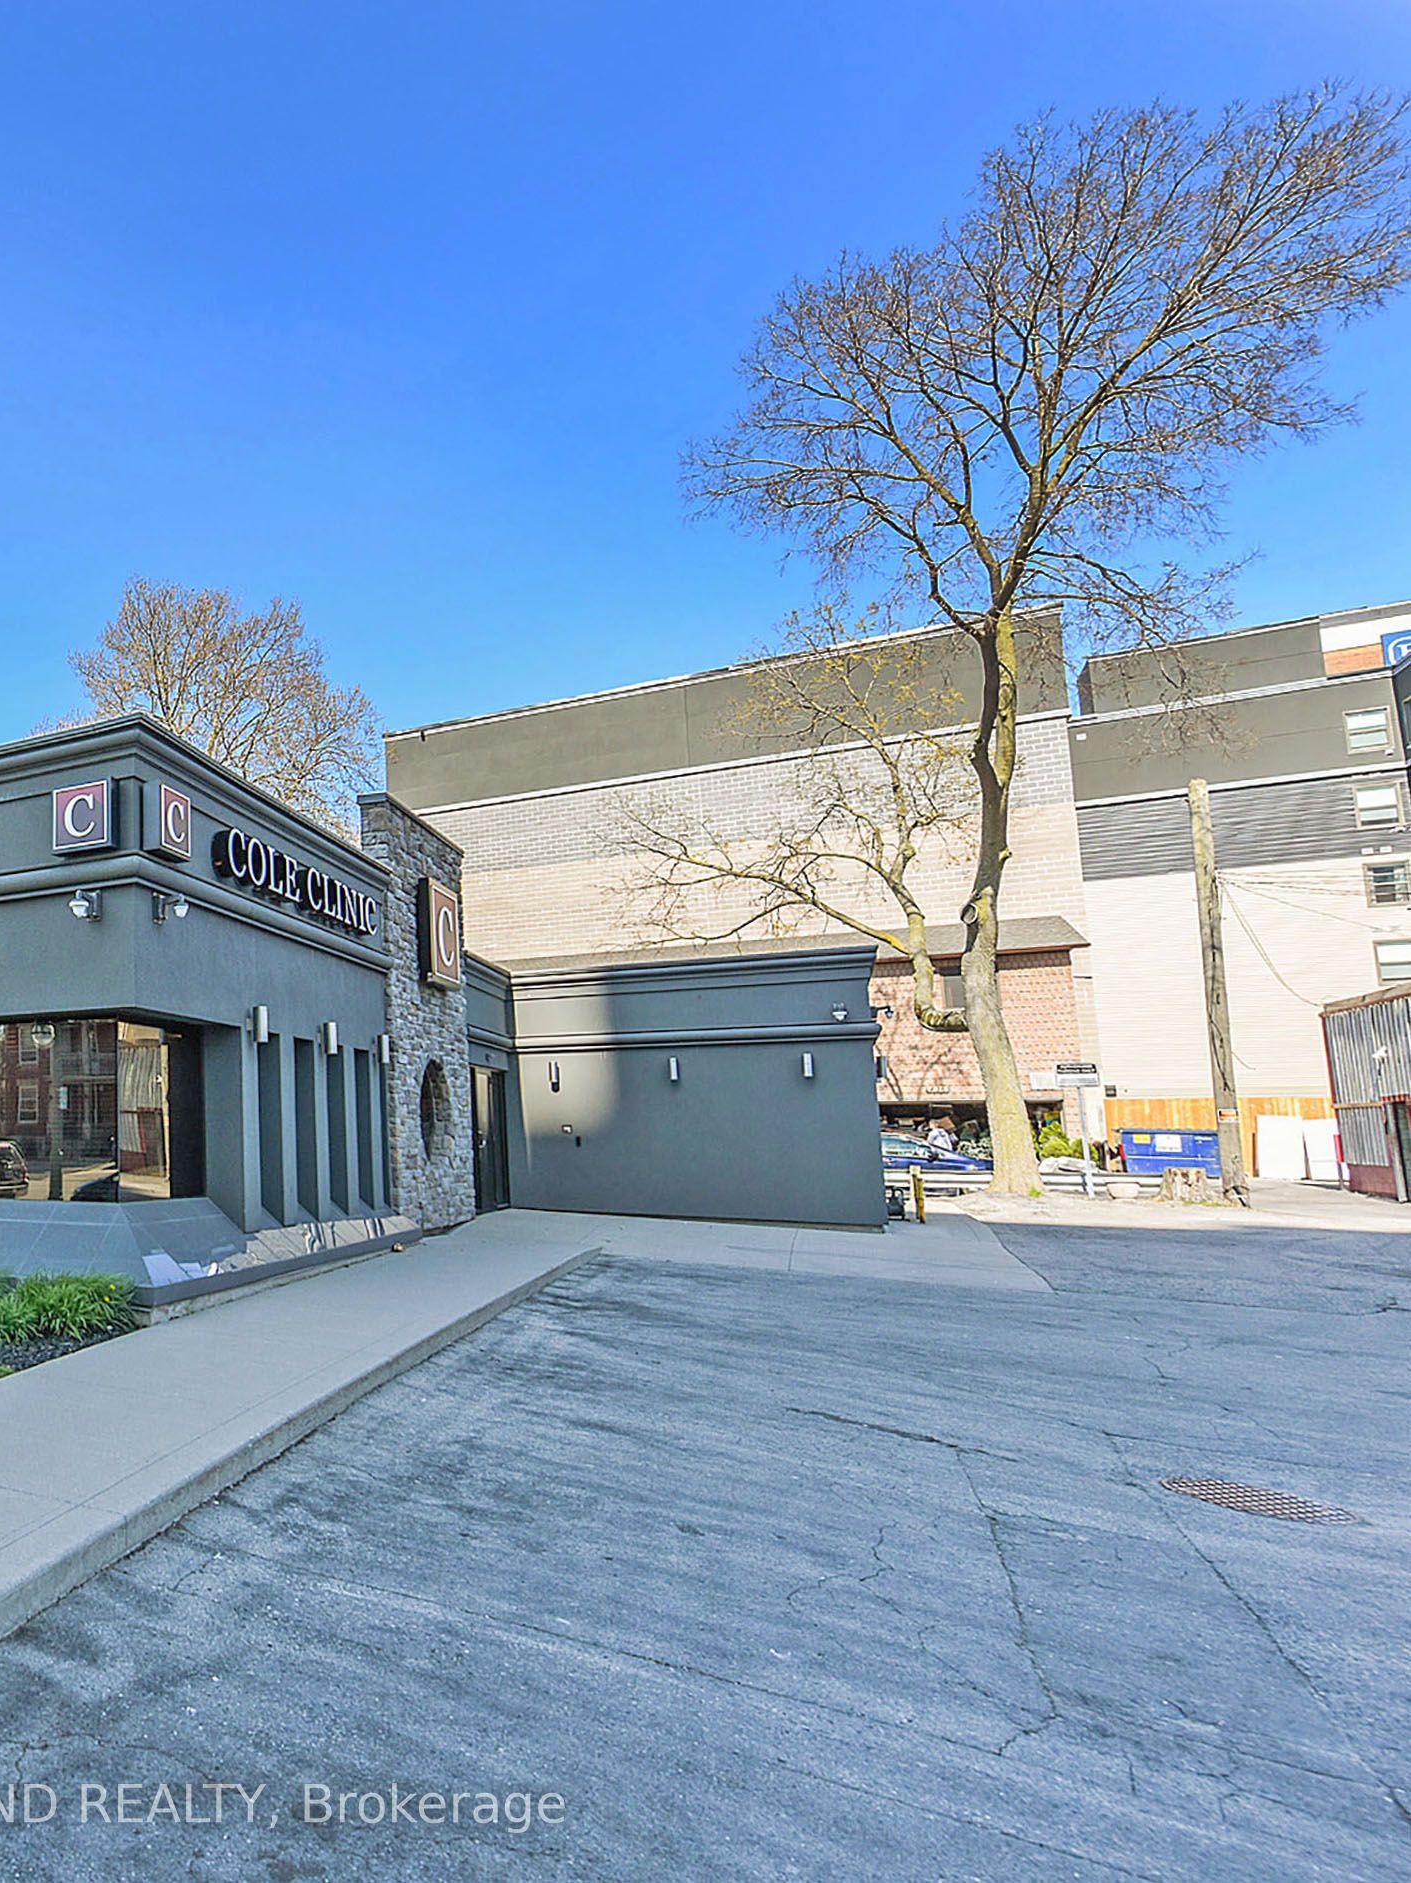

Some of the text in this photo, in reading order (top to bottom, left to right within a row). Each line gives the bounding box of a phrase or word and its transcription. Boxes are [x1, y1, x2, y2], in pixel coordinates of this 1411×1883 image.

[63, 794, 96, 838] C
[165, 800, 186, 844] C
[226, 827, 380, 937] COLE CLINIC
[436, 906, 456, 967] C
